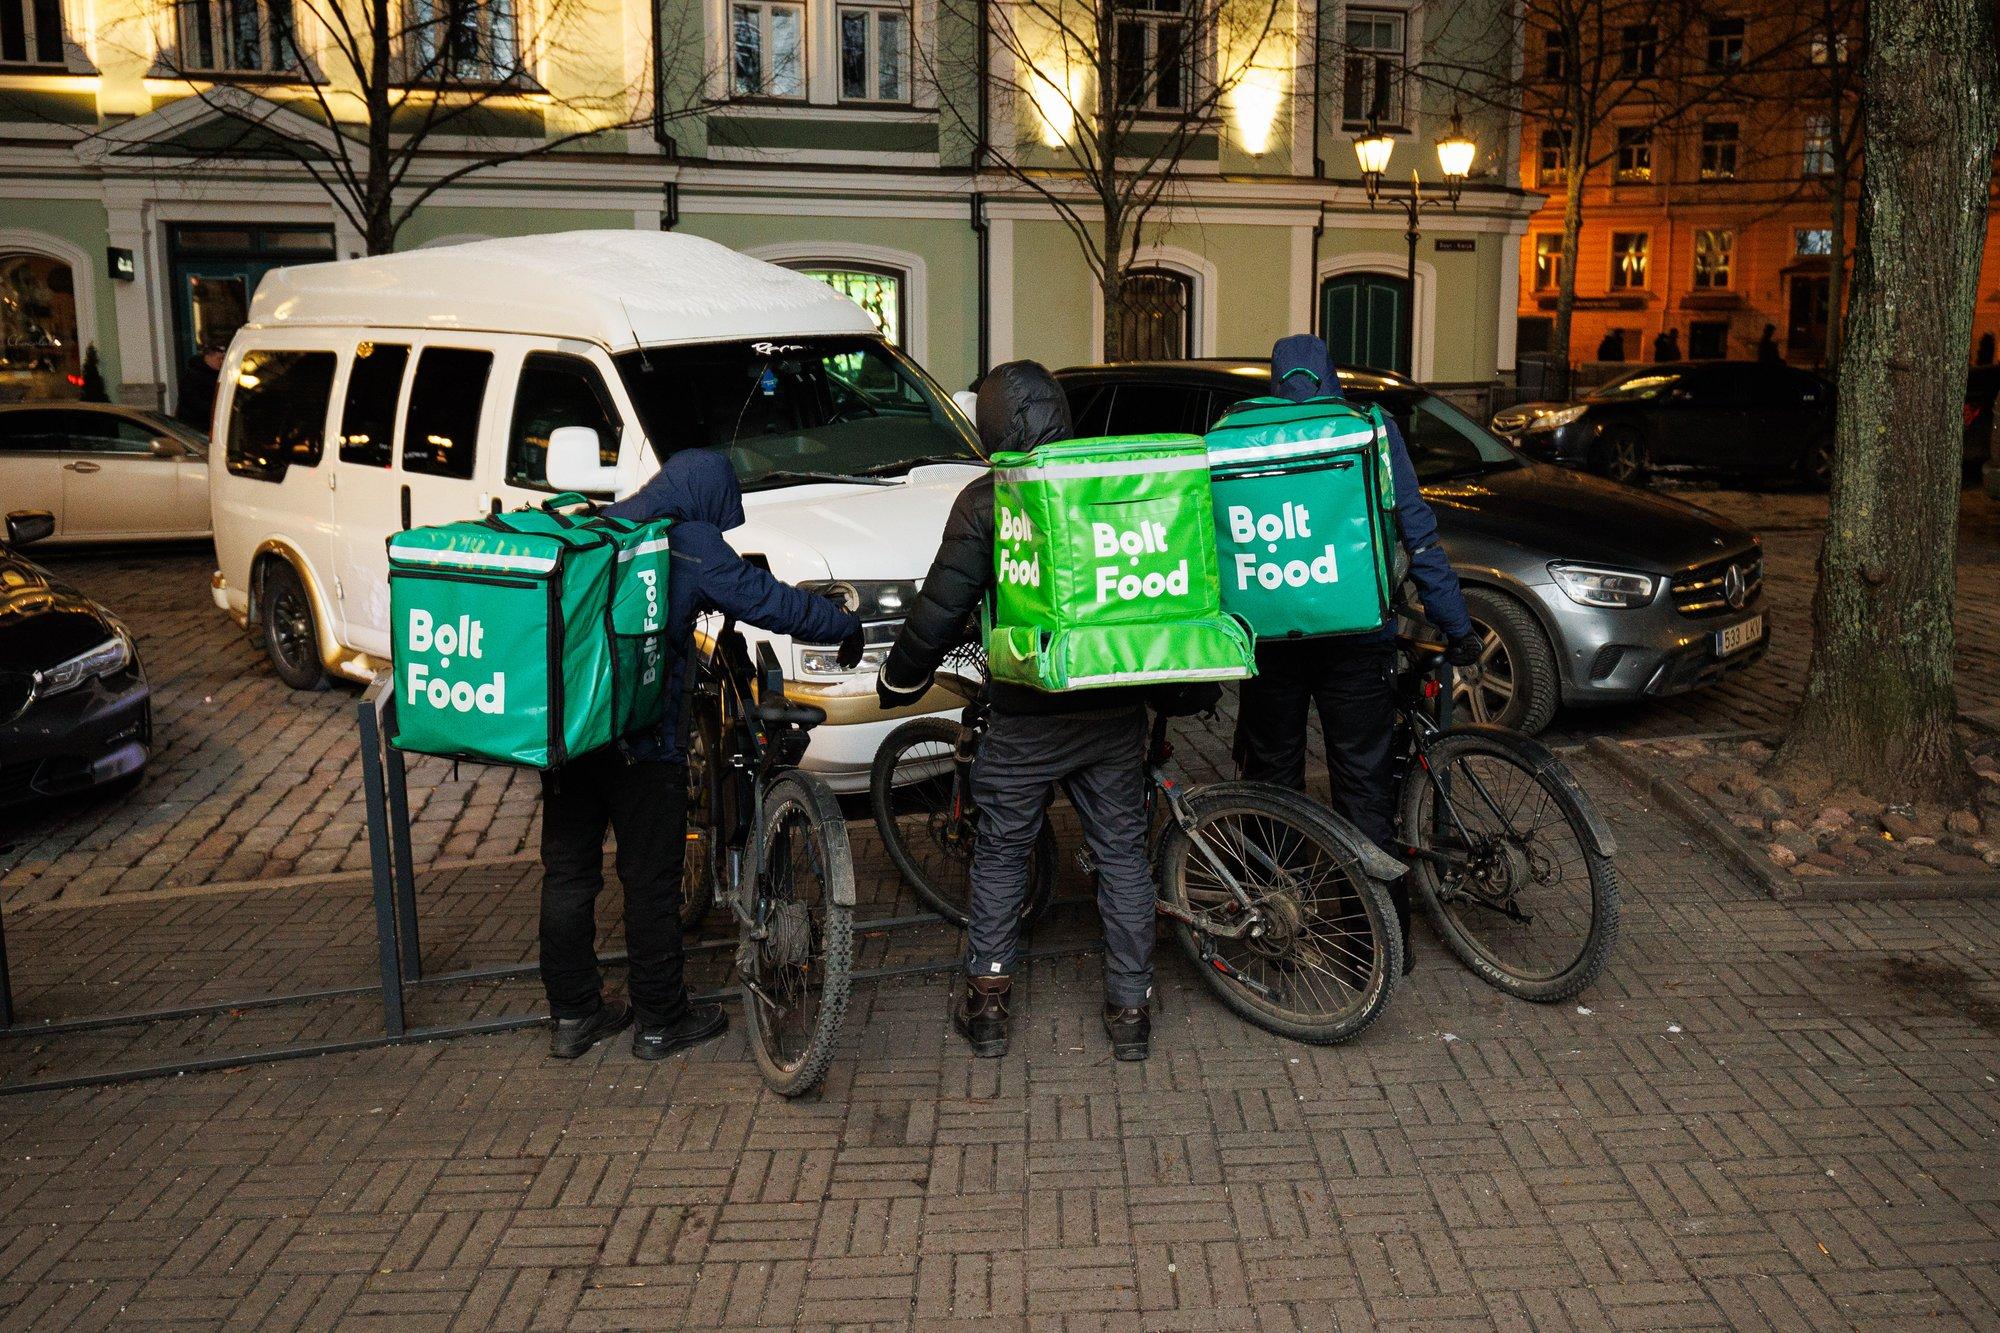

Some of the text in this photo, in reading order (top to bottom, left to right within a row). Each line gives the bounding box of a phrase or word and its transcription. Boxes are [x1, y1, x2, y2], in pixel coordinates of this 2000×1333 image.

[1000, 506, 1033, 549] Bolt
[1091, 519, 1169, 563] Bolt
[1228, 501, 1312, 551] Bolt
[998, 548, 1041, 588] Food
[1096, 559, 1189, 603] Food
[1234, 543, 1339, 590] Food
[636, 569, 659, 632] Food
[408, 608, 485, 664] Bolt
[1725, 627, 1740, 649] 533
[407, 662, 505, 715] Food
[1474, 957, 1521, 988] KENDA
